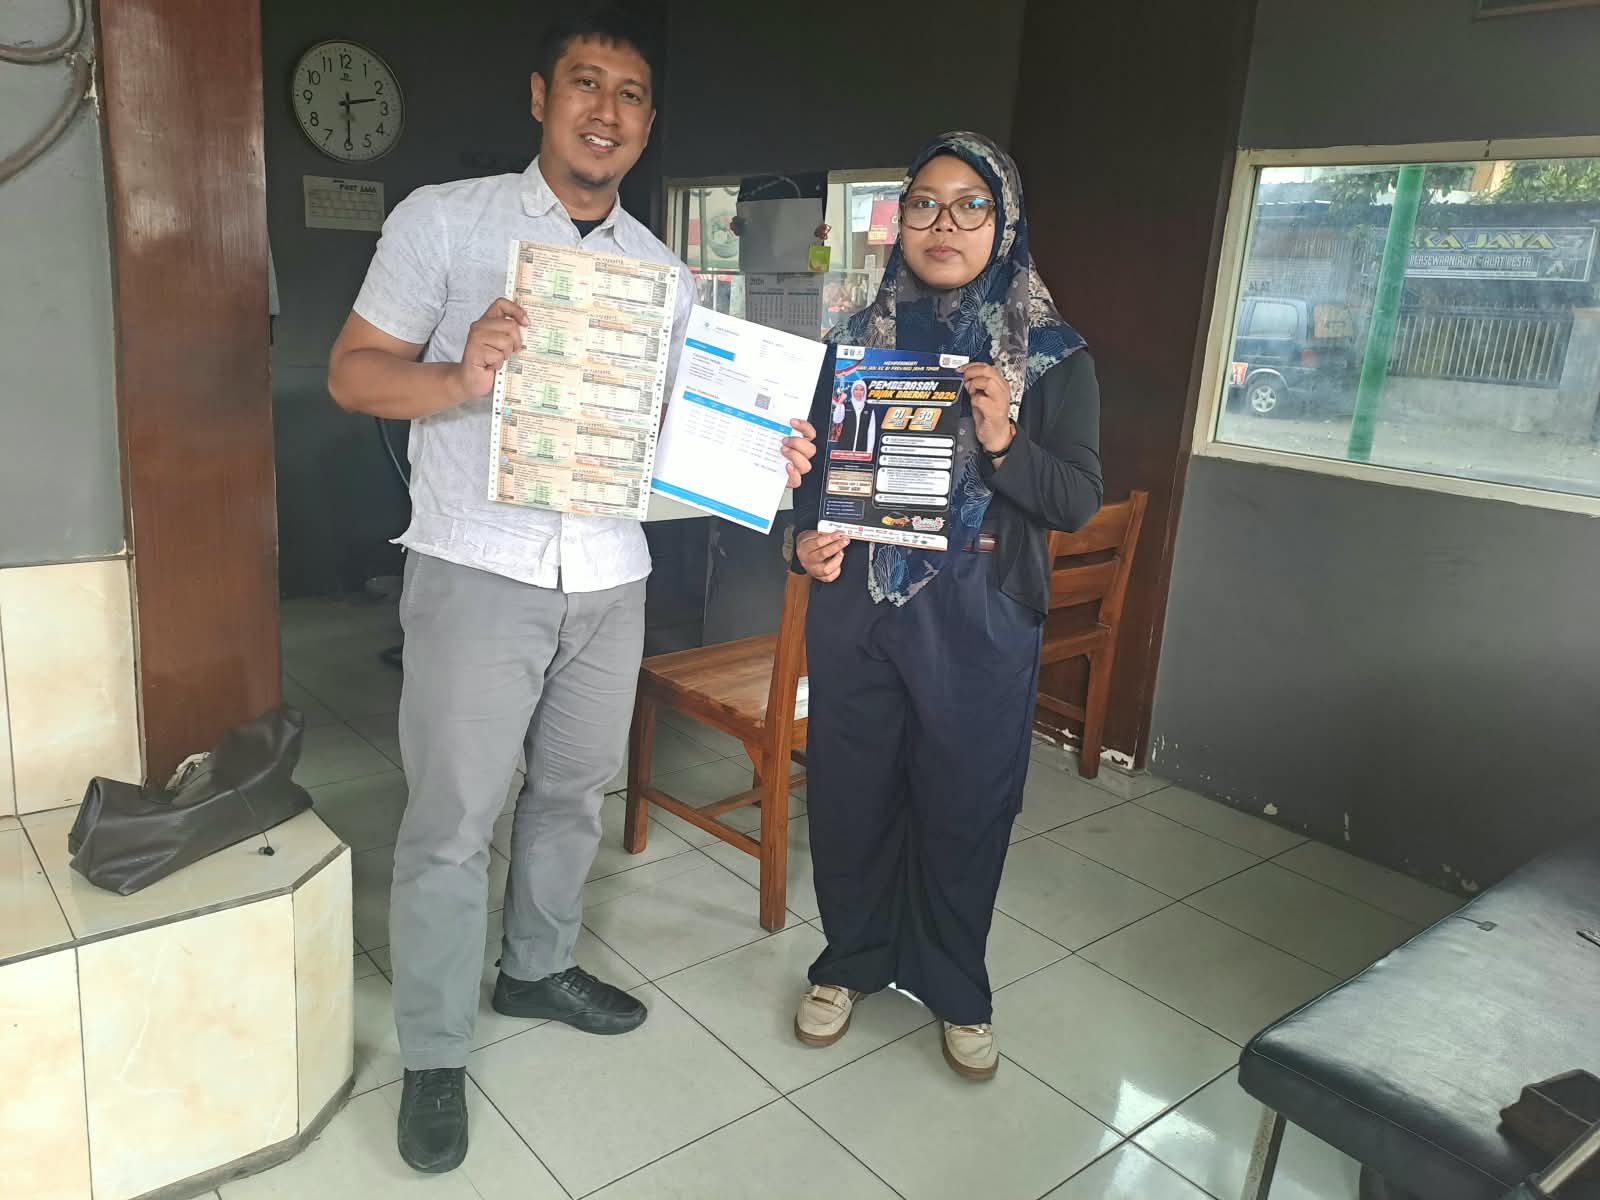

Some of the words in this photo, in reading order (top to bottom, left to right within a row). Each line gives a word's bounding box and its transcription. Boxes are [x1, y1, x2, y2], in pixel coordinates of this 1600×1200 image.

[322, 56, 333, 73] 11
[339, 53, 352, 69] 12
[307, 70, 321, 85] 10
[362, 63, 367, 78] 1
[374, 80, 384, 95] 2
[302, 89, 313, 104] 9
[380, 101, 389, 116] 3
[309, 111, 320, 127] 8
[323, 128, 333, 142] 7
[375, 122, 384, 136] 4
[343, 137, 353, 151] 6
[363, 133, 372, 148] 5
[1467, 231, 1555, 249] JAYA
[868, 381, 938, 391] PEMBEBASAN
[868, 390, 894, 399] PAJAK
[896, 390, 931, 400] DAERAH
[931, 391, 957, 400] 2026
